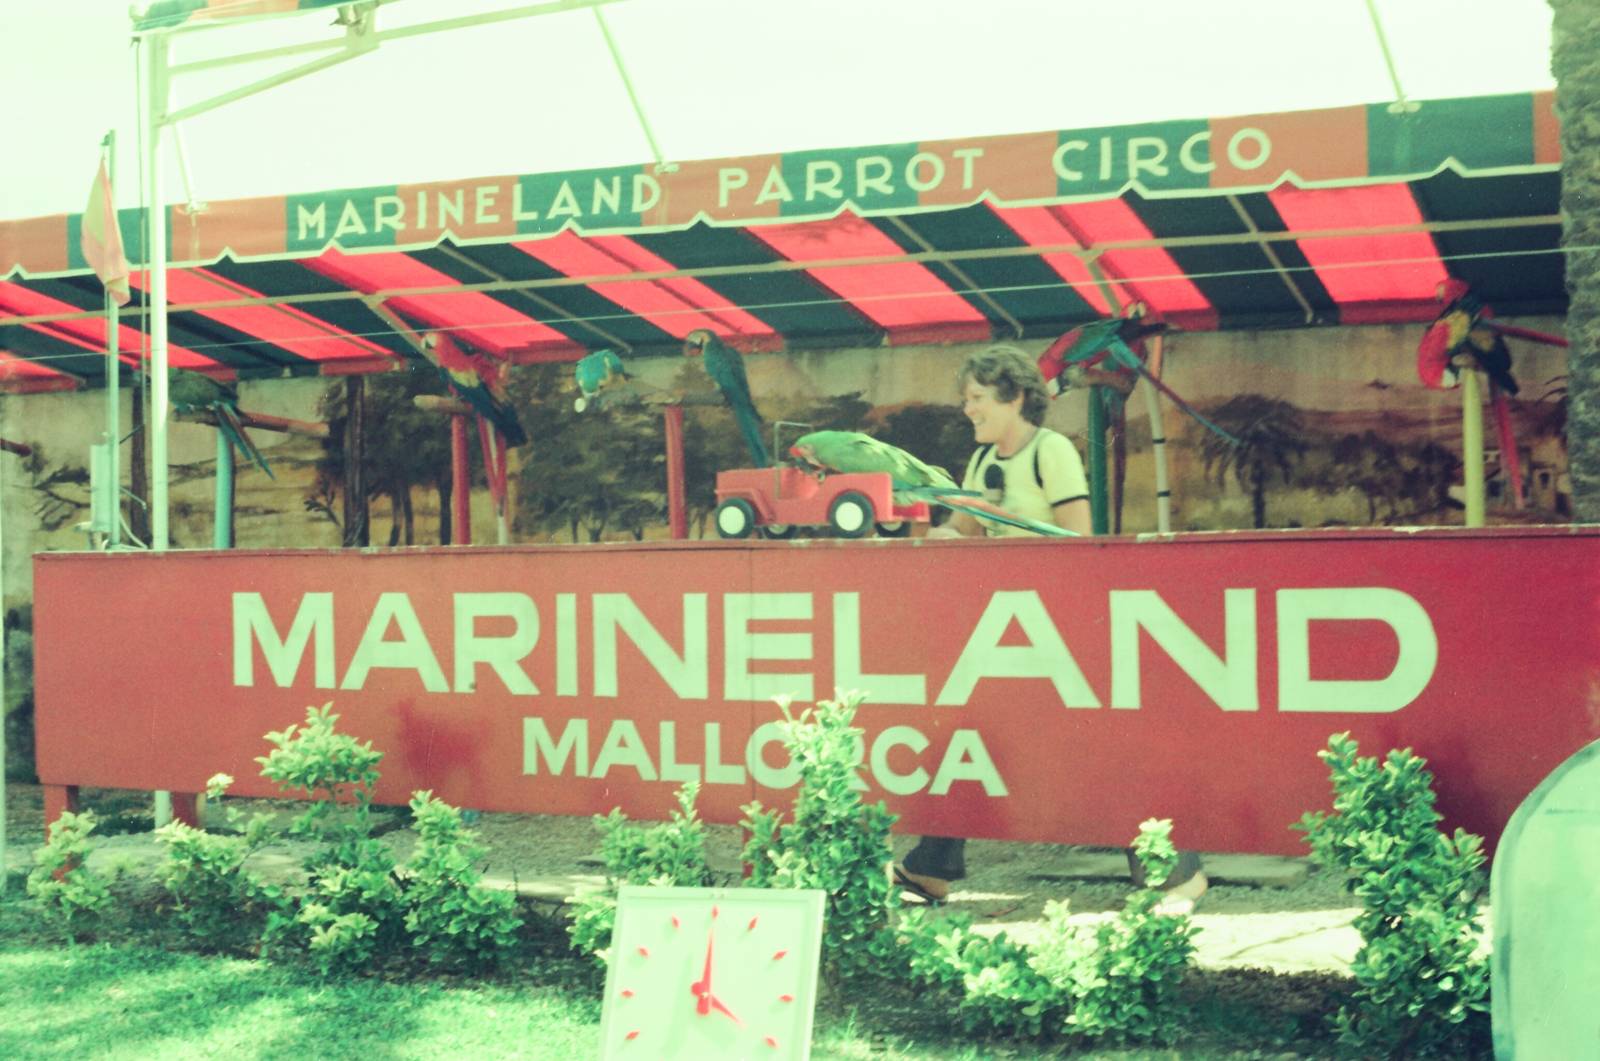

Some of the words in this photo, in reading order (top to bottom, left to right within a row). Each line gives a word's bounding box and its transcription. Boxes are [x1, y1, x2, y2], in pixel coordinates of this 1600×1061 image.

[297, 173, 662, 241] MARINELAND
[718, 148, 984, 207] PARROT
[1052, 127, 1272, 181] CIRCO
[232, 587, 1439, 713] MARINELAND
